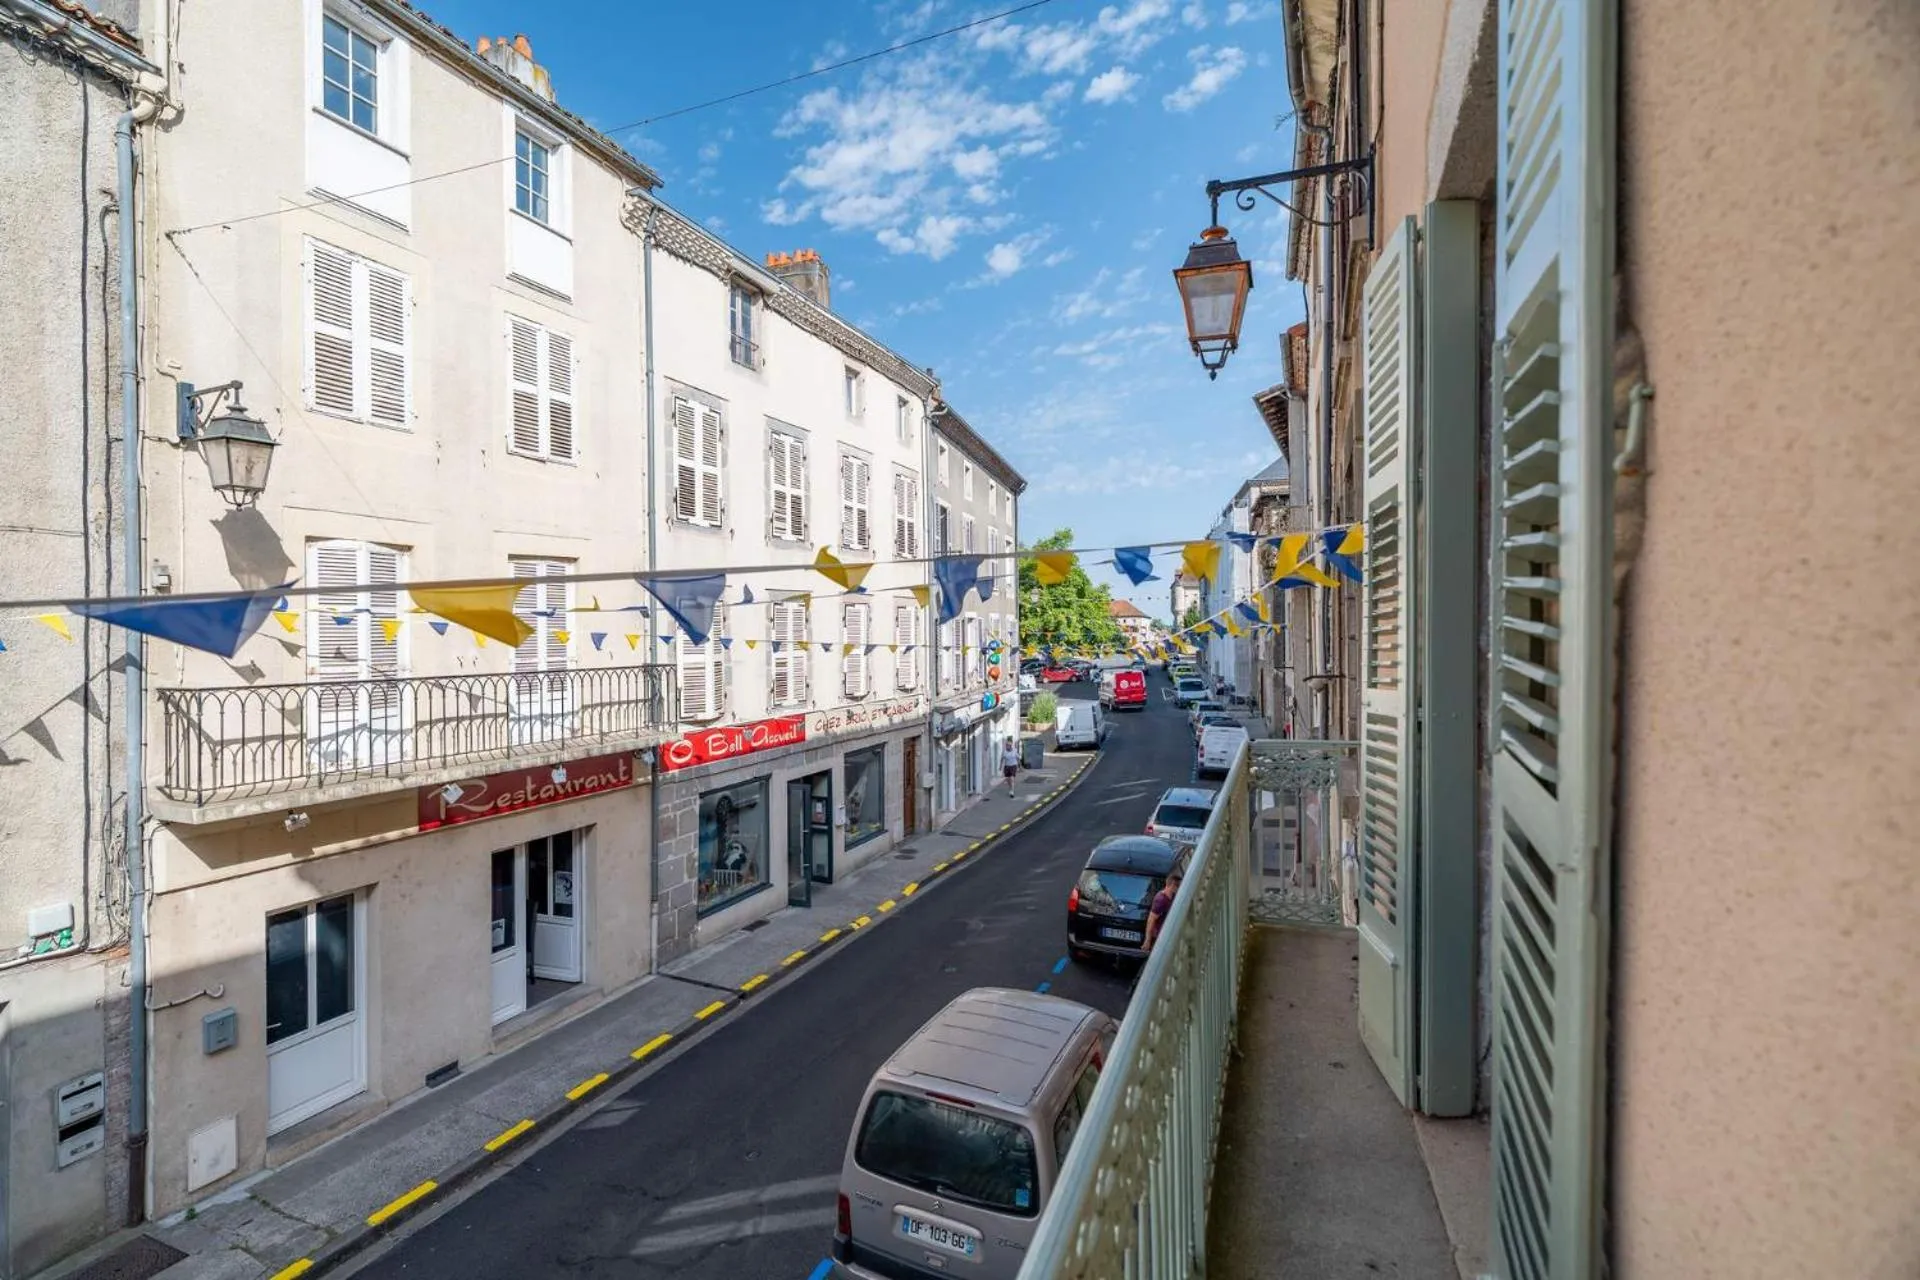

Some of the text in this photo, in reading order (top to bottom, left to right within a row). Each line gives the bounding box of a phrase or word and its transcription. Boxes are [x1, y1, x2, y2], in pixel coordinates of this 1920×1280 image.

[705, 733, 743, 756] Bell
[751, 724, 798, 747] Accueil
[815, 716, 841, 732] CHEZ
[427, 758, 630, 820] Restaurant
